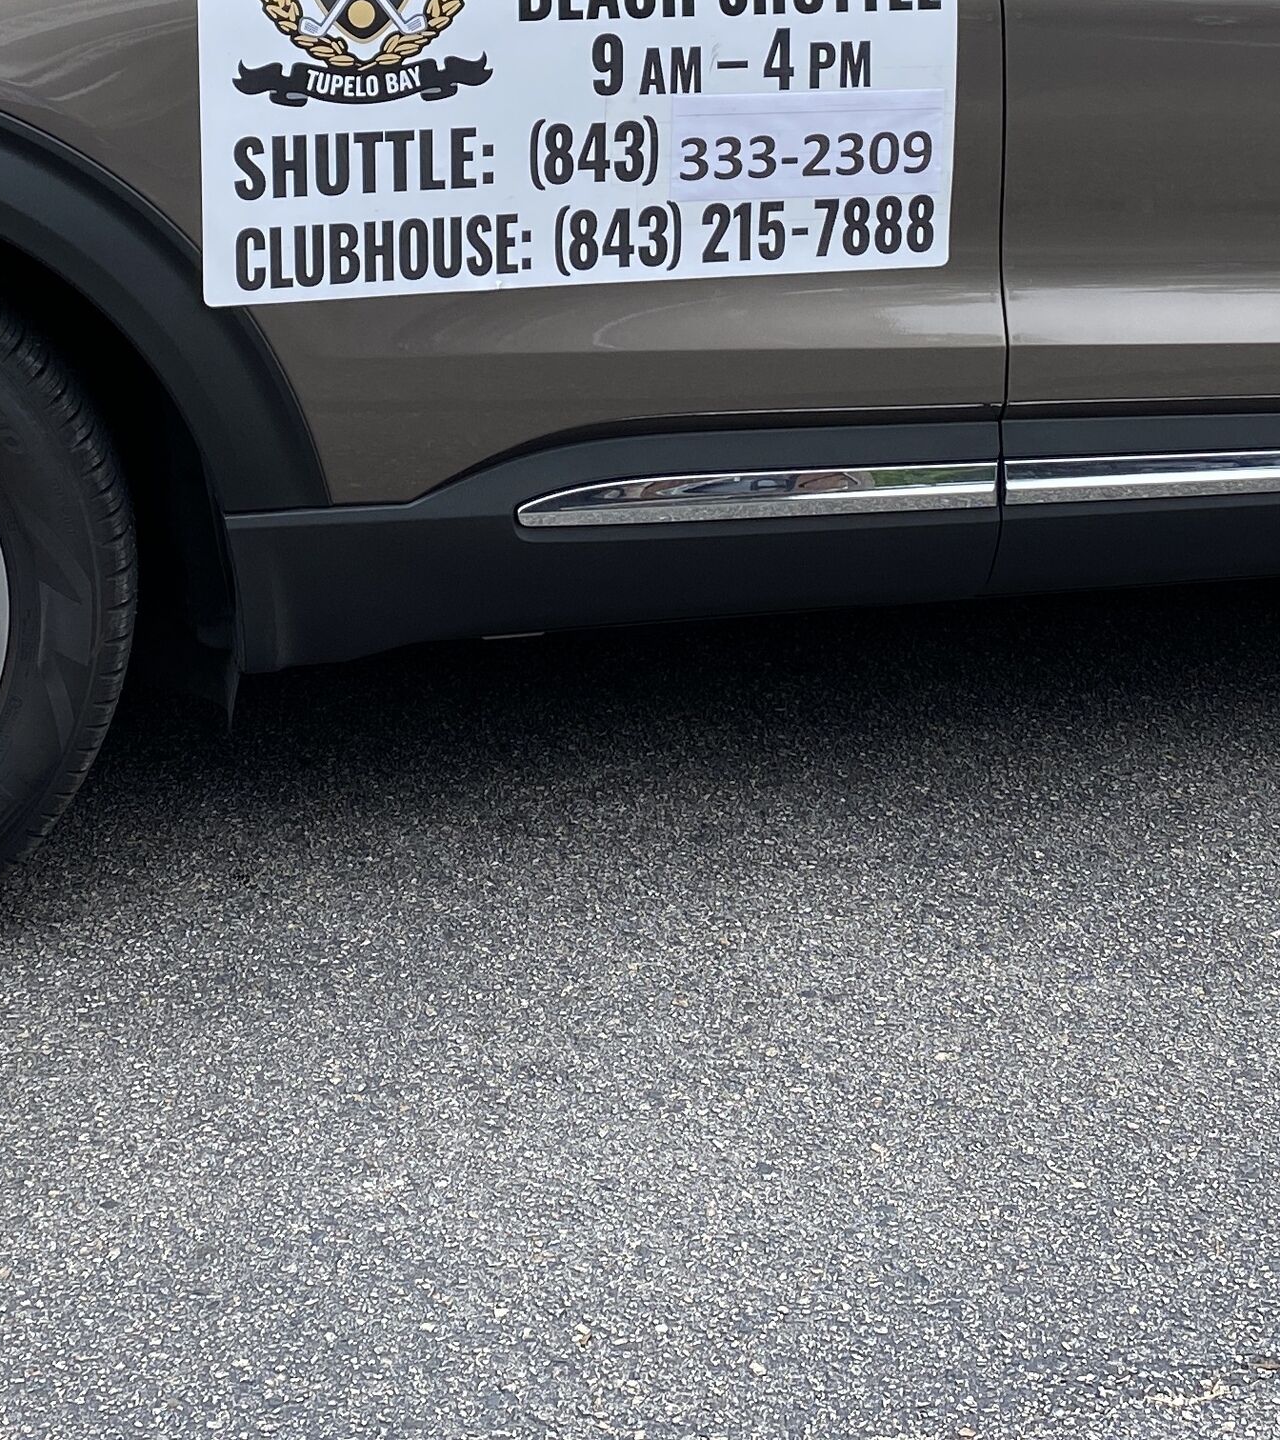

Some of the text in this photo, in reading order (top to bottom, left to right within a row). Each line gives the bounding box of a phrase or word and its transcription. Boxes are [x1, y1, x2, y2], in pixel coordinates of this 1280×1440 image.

[306, 66, 421, 97] TUPELO BAY
[591, 32, 625, 96] 9
[639, 46, 702, 95] AM
[763, 27, 795, 90] 4
[810, 41, 872, 89] PM
[233, 116, 933, 200] SHUTTLE: (843) 333-2309
[235, 194, 936, 291] CLUBHOUSE: (843) 215-7888
